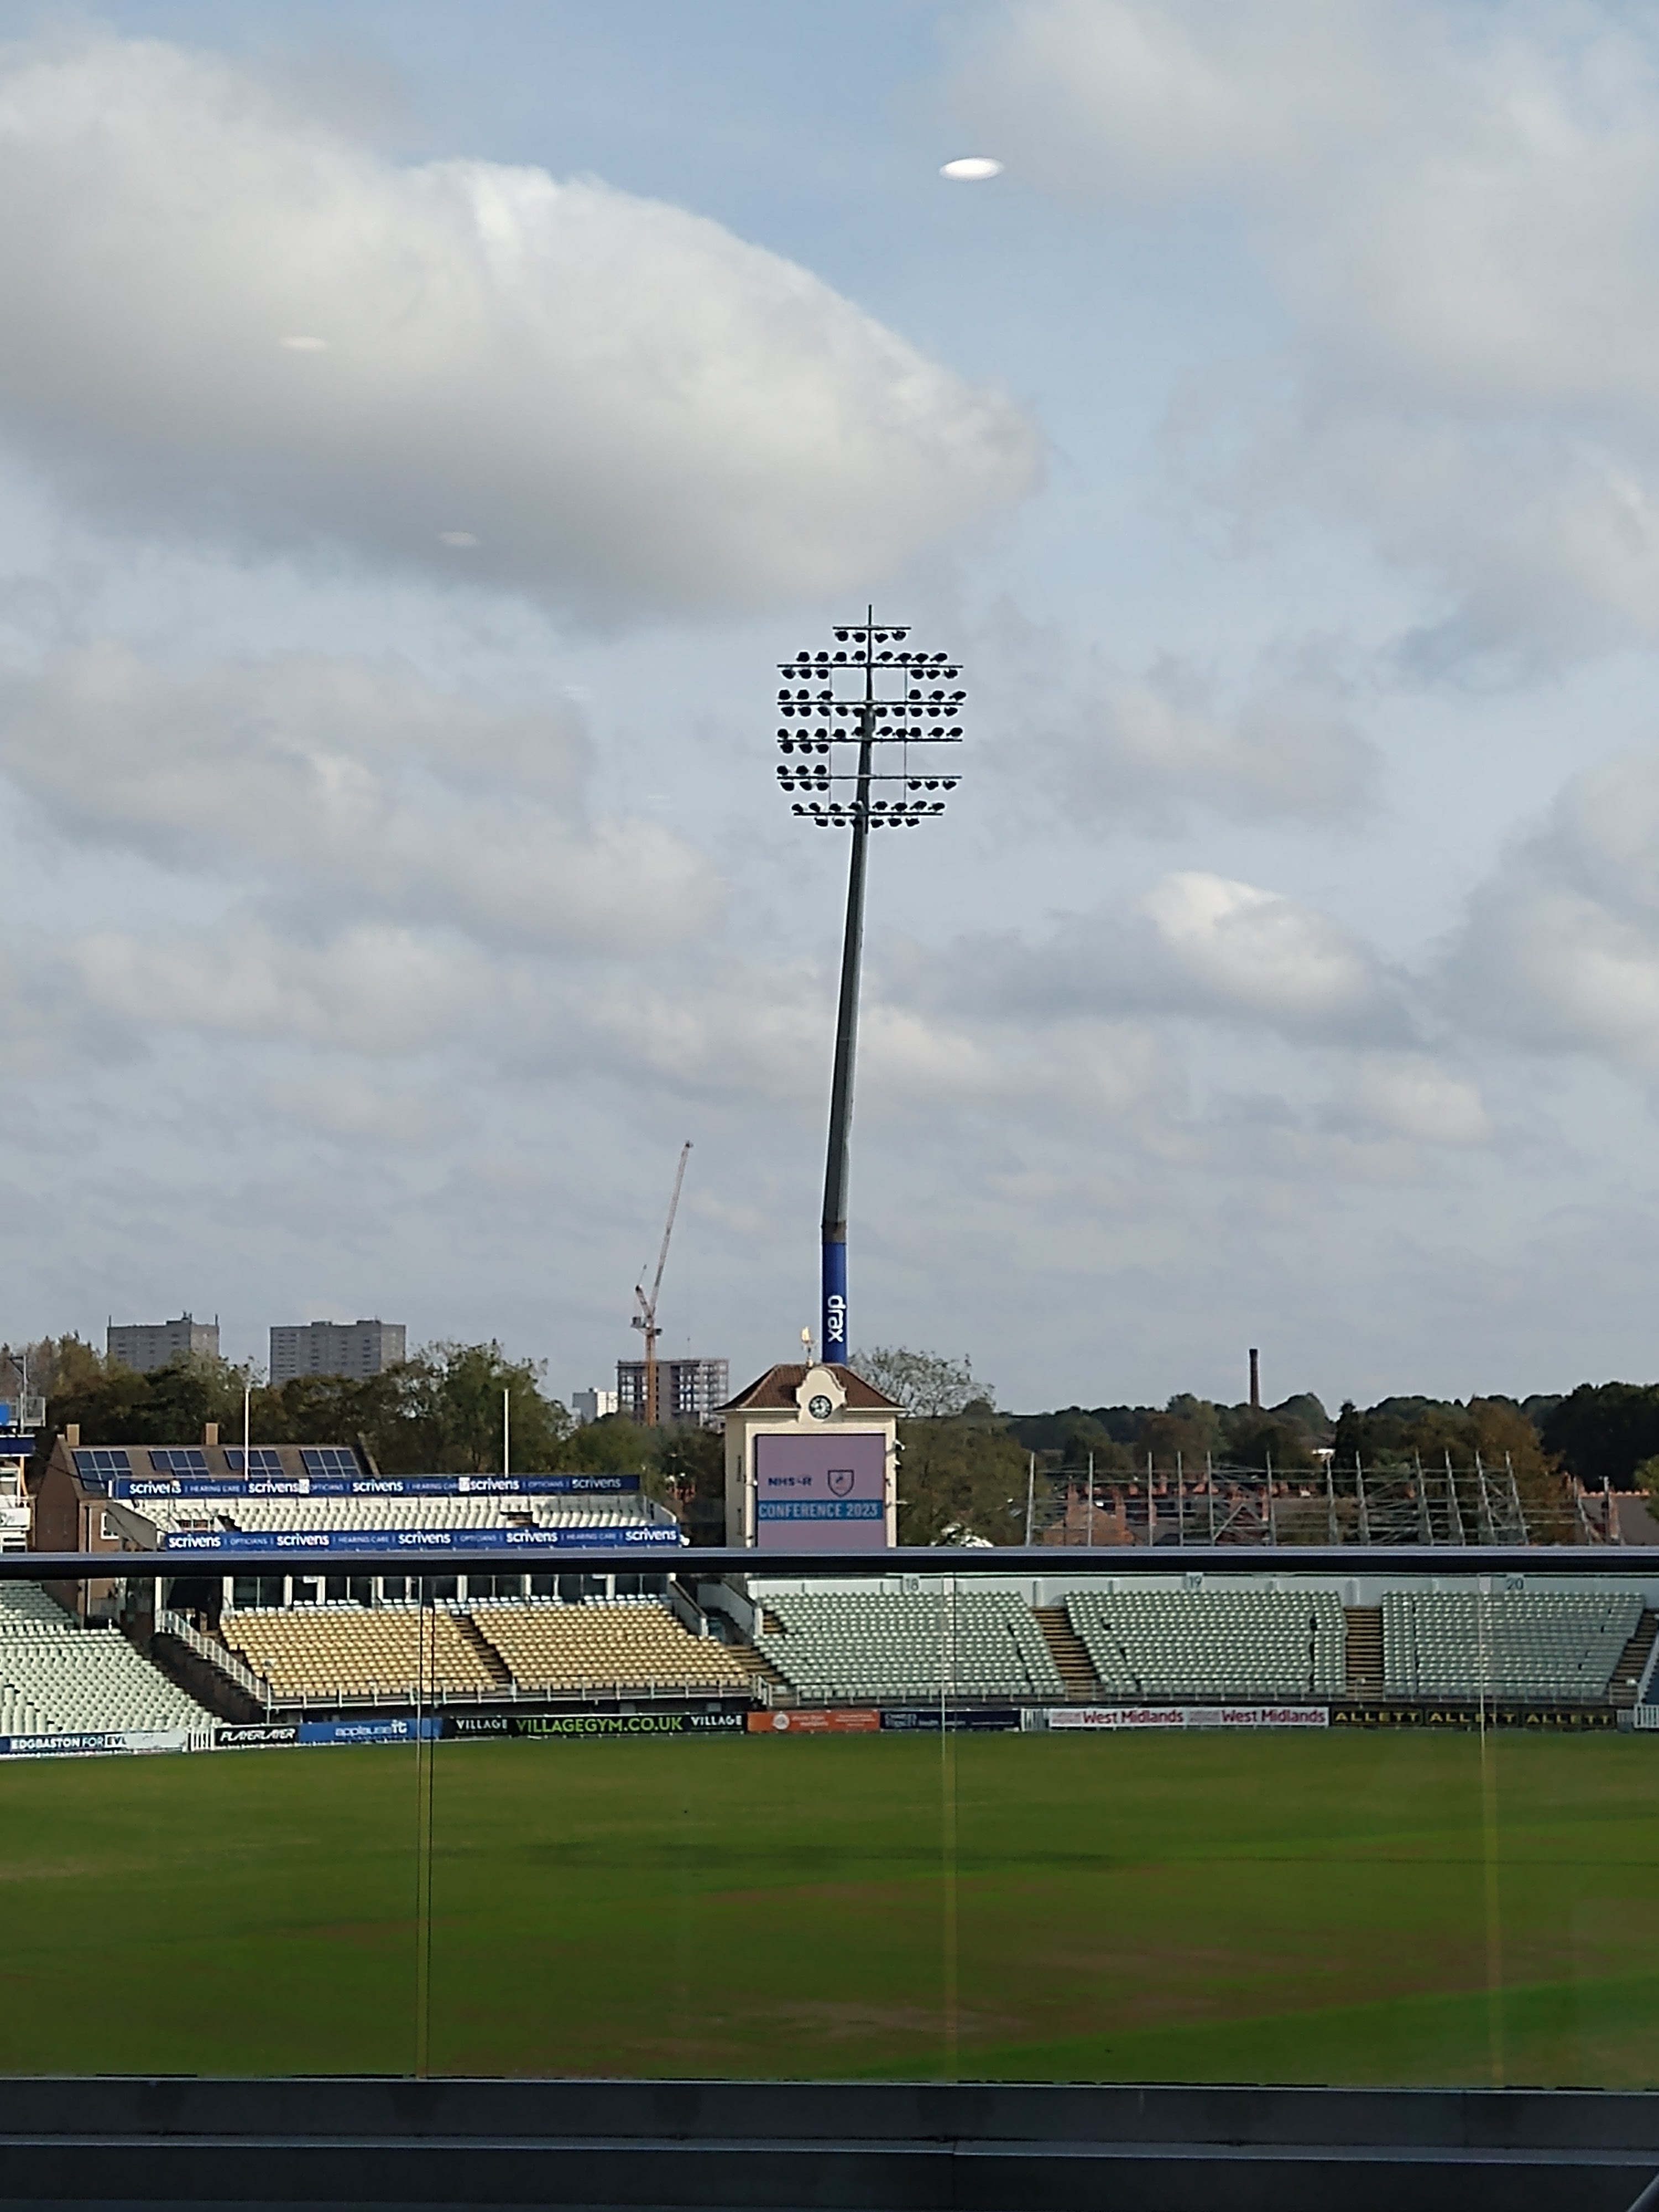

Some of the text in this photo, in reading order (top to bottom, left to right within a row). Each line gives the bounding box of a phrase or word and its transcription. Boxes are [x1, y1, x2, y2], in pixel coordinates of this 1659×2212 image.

[827, 1295, 847, 1343] drax
[129, 1480, 181, 1494] scrivens
[248, 1479, 299, 1493] scrivens
[353, 1479, 403, 1492] scrivens
[470, 1478, 519, 1490] scrivens
[572, 1477, 621, 1489] scrivens
[759, 1503, 877, 1517] CONFERENCE 2023
[169, 1533, 221, 1548] scrivens
[277, 1533, 329, 1546] scrivens
[398, 1531, 451, 1544] scrivens
[506, 1529, 558, 1542] scrivens
[625, 1527, 676, 1541] scrivens
[906, 1578, 919, 1591] 18
[1189, 1575, 1202, 1589] 19
[1506, 1578, 1524, 1590] 20
[691, 1715, 742, 1726] VILLAGE
[1083, 1710, 1118, 1724] West
[1121, 1709, 1183, 1723] Midlands
[1222, 1709, 1257, 1723] West
[1261, 1709, 1325, 1723] Midlands
[1334, 1712, 1419, 1722] ALLETT
[456, 1719, 508, 1730] VILLAGE
[516, 1716, 683, 1733] VILLAGEGYM.CO.UK
[220, 1728, 296, 1741] PLAYERLAYER
